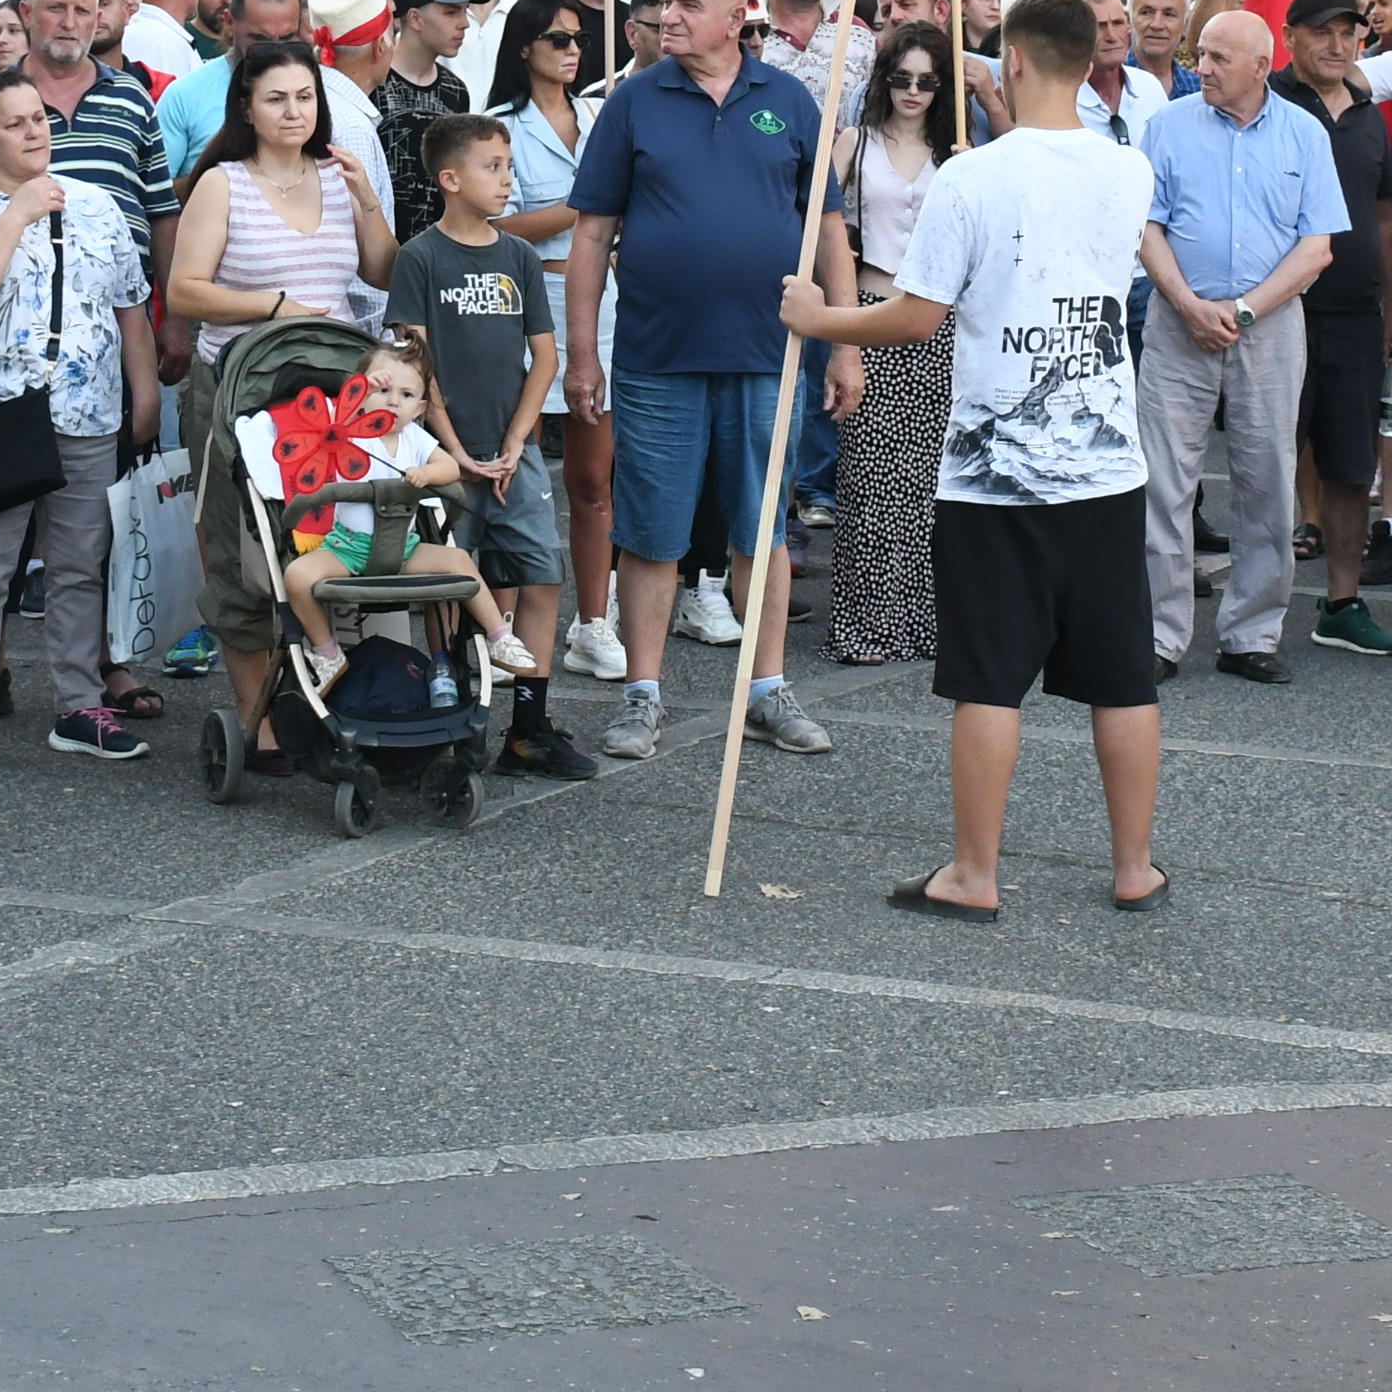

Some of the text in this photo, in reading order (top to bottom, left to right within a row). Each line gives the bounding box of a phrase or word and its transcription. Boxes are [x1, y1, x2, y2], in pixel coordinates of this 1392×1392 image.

[463, 272, 496, 288] THE
[439, 286, 498, 305] NORTH
[457, 300, 499, 315] FACE
[1052, 295, 1101, 325] THE
[1001, 323, 1098, 355] NORTH
[1029, 351, 1093, 383] FACE
